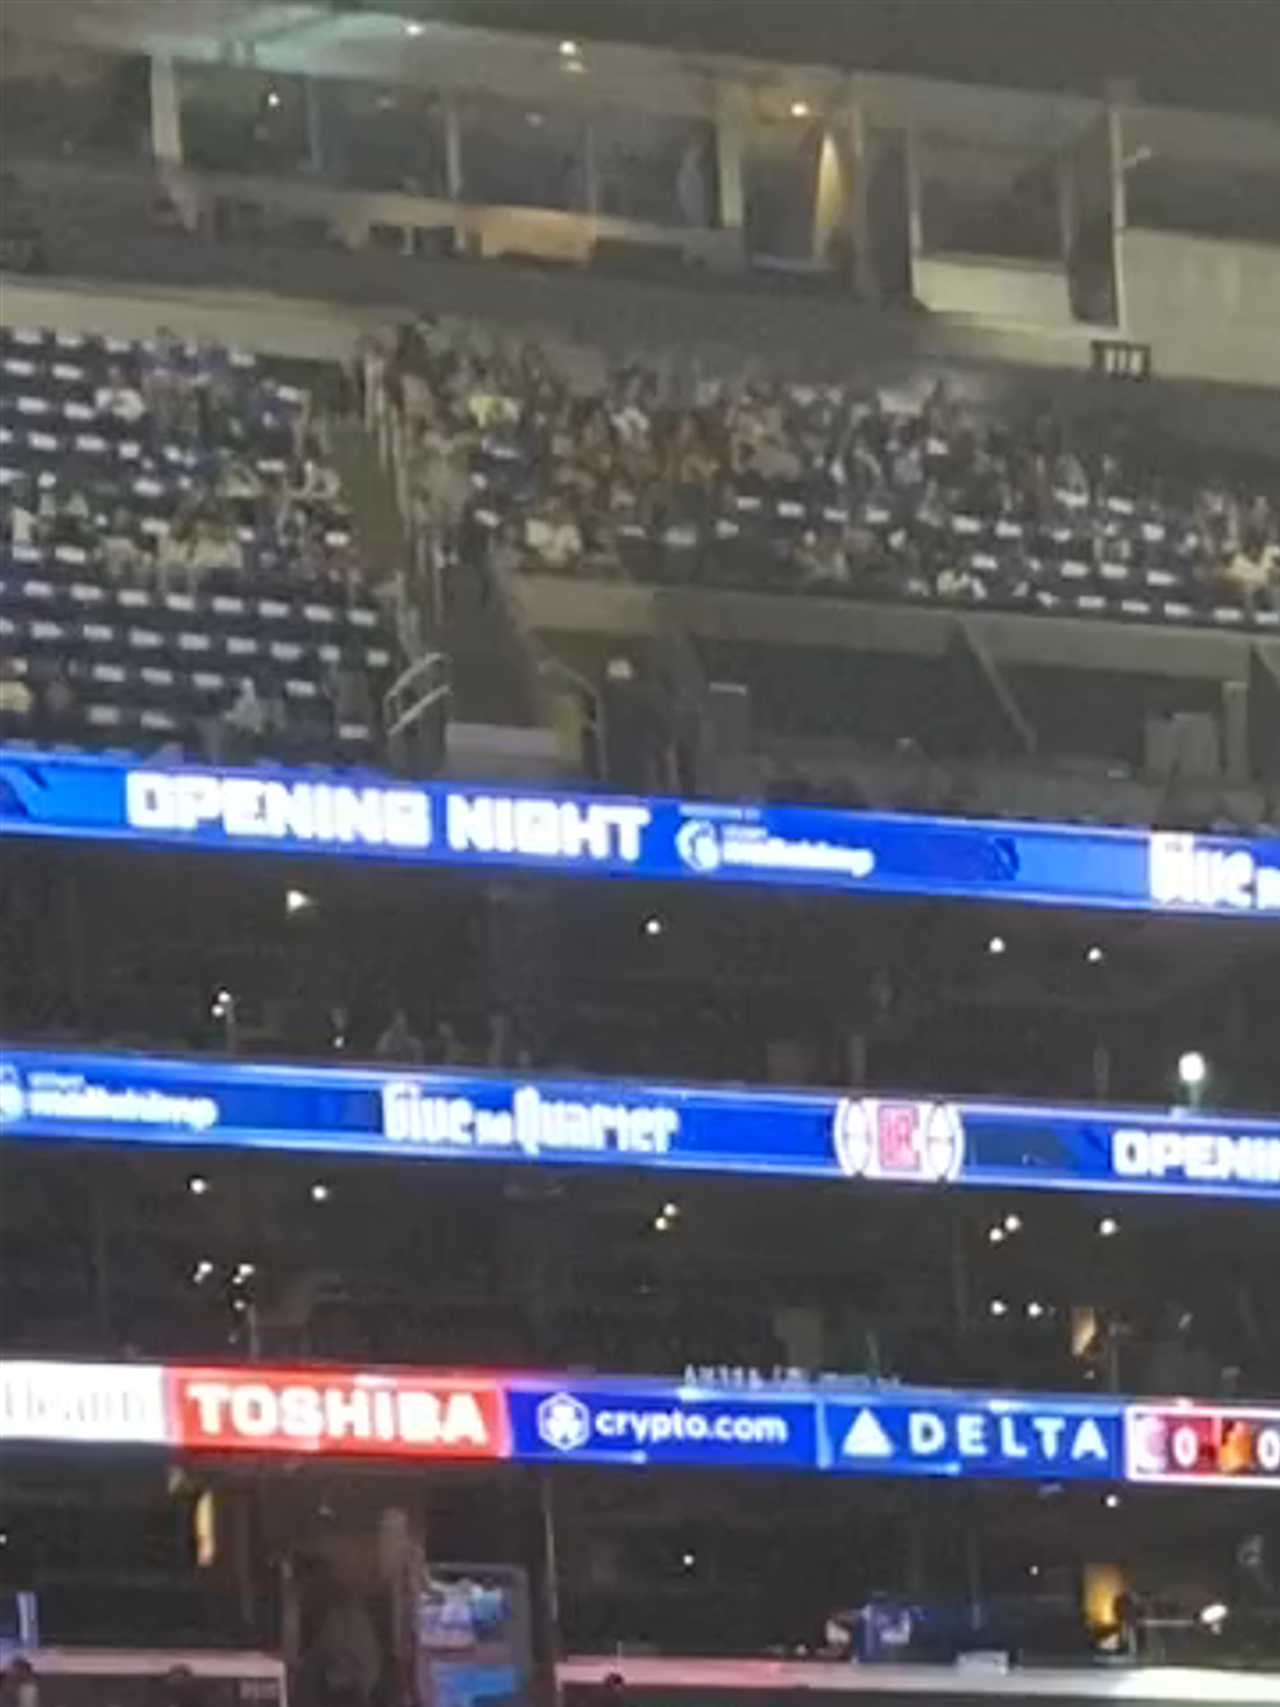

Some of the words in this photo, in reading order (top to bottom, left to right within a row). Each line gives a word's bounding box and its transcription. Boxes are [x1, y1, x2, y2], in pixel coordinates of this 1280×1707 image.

[127, 770, 430, 847] OPENING
[447, 794, 649, 862] NIGHT
[187, 1382, 489, 1444] TOSHIBA
[595, 1407, 788, 1445] crypto.com
[908, 1412, 1108, 1460] DELTA
[1172, 1426, 1197, 1467] 0
